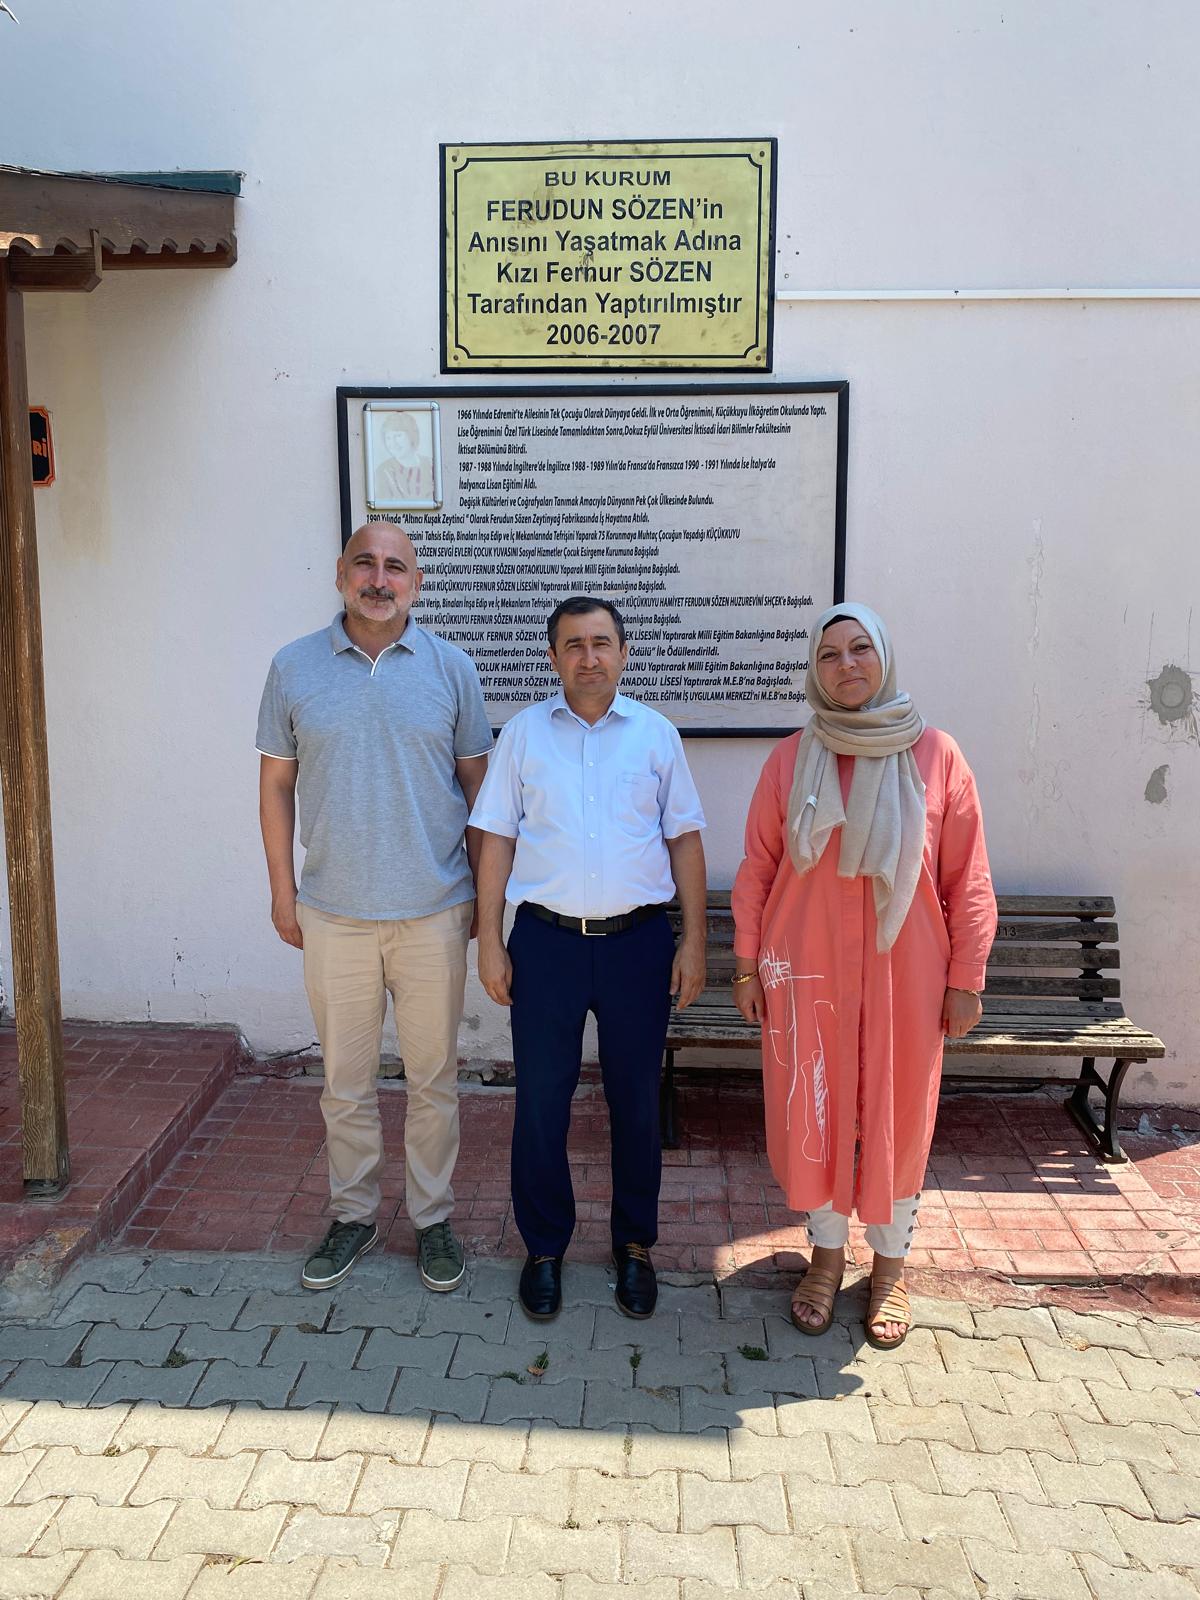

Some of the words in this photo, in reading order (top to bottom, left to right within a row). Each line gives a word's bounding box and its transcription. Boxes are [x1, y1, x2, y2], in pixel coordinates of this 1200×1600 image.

[545, 171, 576, 186] BU
[585, 171, 671, 186] KURUM
[487, 199, 602, 221] FERUDUN
[468, 232, 547, 252] Anısını
[555, 230, 666, 256] Yaşatmak
[674, 230, 742, 251] Adına
[498, 262, 538, 282] Kızı
[547, 262, 622, 282] Fernur
[630, 257, 712, 282] SÖZEN
[467, 293, 587, 314] Tarafından
[595, 292, 742, 318] Yaptırılmıştır
[546, 324, 661, 345] 2006-2007
[457, 409, 472, 420] 1966
[472, 409, 493, 419] Yılında
[524, 408, 550, 419] Ailesinin
[550, 408, 560, 418] Tek
[560, 408, 584, 421] Çocuğu
[584, 407, 604, 418] Olarak
[604, 407, 630, 421] Dünyaya
[631, 407, 648, 418] Geldi.
[648, 404, 657, 417] İlk
[658, 409, 664, 417] ve
[664, 406, 680, 417] Orta
[680, 404, 714, 420] Öğrenimini,
[714, 406, 748, 419] Küçükkuyu
[780, 405, 810, 416] Okulunda
[810, 405, 826, 418] Yaptı.
[457, 426, 470, 437] Lise
[470, 424, 502, 439] Öğrenimini
[504, 423, 518, 436] Özel
[518, 426, 531, 436] Türk
[532, 425, 559, 436] Lisesinde
[560, 425, 605, 436] Tamamladıktan
[644, 424, 658, 438] Eylül
[658, 422, 694, 435] Üniversitesi
[694, 422, 716, 435] İktisadi
[716, 422, 732, 434] İdari
[732, 424, 754, 434] Bilimler
[754, 423, 792, 434] Fakültesinin
[458, 441, 476, 454] İktisat
[476, 443, 508, 454] Bölümünü
[508, 443, 527, 454] Bitirdi.
[459, 461, 474, 472] 1987
[478, 461, 492, 472] 1988
[492, 461, 512, 471] Yılında
[546, 458, 571, 474] İngilizce
[571, 460, 586, 471] 1988
[590, 460, 605, 471] 1989
[656, 459, 684, 470] Fransızca
[685, 459, 700, 470] 1990
[704, 459, 719, 470] 1991
[720, 459, 740, 470] Yılında
[740, 456, 750, 469] İse
[458, 476, 486, 492] İtalyanca
[486, 479, 502, 489] Lisan
[502, 478, 524, 492] Eğitimi
[524, 478, 537, 489] Aldı.
[459, 496, 481, 509] Değişik
[482, 496, 510, 506] Kültürleri
[510, 498, 516, 506] ve
[516, 495, 554, 509] Coğrafyaları
[554, 495, 578, 506] Tanımak
[579, 495, 606, 508] Amacıyla
[606, 495, 635, 508] Dünyanın
[636, 494, 646, 505] Pek
[646, 494, 658, 508] Çok
[659, 492, 688, 505] Ülkesinde
[688, 494, 714, 505] Bulundu.
[424, 513, 442, 526] Kuşak
[442, 513, 466, 526] Zeytinci
[470, 513, 490, 523] Olarak
[490, 512, 514, 523] Ferudun
[514, 512, 532, 523] Sözen
[562, 512, 598, 523] Fabrikasında
[598, 510, 604, 526] İş
[604, 512, 632, 526] Hayatına
[632, 512, 649, 523] Atıldı.
[424, 530, 442, 541] Tahsis
[598, 529, 606, 540] 75
[706, 526, 740, 542] KÜÇÜKKUYU
[436, 561, 472, 577] KÜÇÜKKUYU
[472, 563, 496, 574] FERNUR
[496, 561, 516, 574] SÖZEN
[516, 563, 560, 574] ORTAOKULUNU
[560, 563, 584, 576] Yaparak
[584, 563, 598, 574] Milli
[598, 563, 616, 576] Eğitim
[616, 563, 652, 576] Bakanlığına
[652, 563, 680, 576] Bağışladı.
[436, 578, 472, 594] KÜÇÜKKUYU
[472, 580, 496, 591] FERNUR
[496, 578, 516, 591] SÖZEN
[516, 578, 540, 591] LİSESİNİ
[540, 580, 570, 593] Yaptırarak
[570, 580, 584, 591] Milli
[584, 580, 602, 593] Eğitim
[602, 580, 638, 593] Bakanlığına
[638, 580, 666, 593] Bağışladı.
[626, 593, 660, 609] KÜÇÜKKUYU
[660, 593, 684, 606] HAMİYET
[684, 595, 712, 606] FERUDUN
[712, 592, 730, 606] SÖZEN
[730, 592, 764, 605] HUZUREVİNİ
[786, 594, 813, 608] Bağışladı.
[434, 611, 470, 627] KÜÇÜKKUYU
[470, 614, 494, 624] FERNUR
[494, 611, 513, 624] SÖZEN
[653, 613, 682, 626] Bağışladı.
[448, 631, 485, 641] ALTINOLUK
[486, 630, 514, 641] FERNUR
[514, 628, 538, 641] SÖZEN
[634, 627, 662, 640] LİSESİNİ
[662, 629, 696, 642] Yaptırarak
[697, 629, 712, 640] Milli
[712, 629, 734, 642] Eğitim
[734, 628, 776, 642] Bakanlığına
[776, 628, 808, 642] Bağışladı.
[475, 646, 524, 657] Hizmetlerden
[656, 643, 666, 656] İle
[666, 643, 720, 656] Ödüllendirildi.
[500, 658, 536, 672] HAMİYET
[648, 660, 686, 673] Yaptırarak
[687, 660, 704, 670] Milli
[704, 660, 728, 673] Eğitim
[728, 659, 774, 673] Bakanlığına
[492, 676, 524, 686] FERNUR
[524, 673, 550, 686] SÖZEN
[620, 675, 660, 686] ANADOLU
[660, 673, 684, 686] LİSESİ
[684, 675, 722, 688] Yaptırarak
[756, 675, 792, 688] Bağışladı.
[510, 688, 532, 702] SÖZEN
[635, 693, 644, 701] ve
[644, 688, 660, 701] ÖZEL
[660, 688, 682, 701] EĞİTİM
[682, 688, 689, 704] İŞ
[690, 690, 724, 701] UYGULAMA
